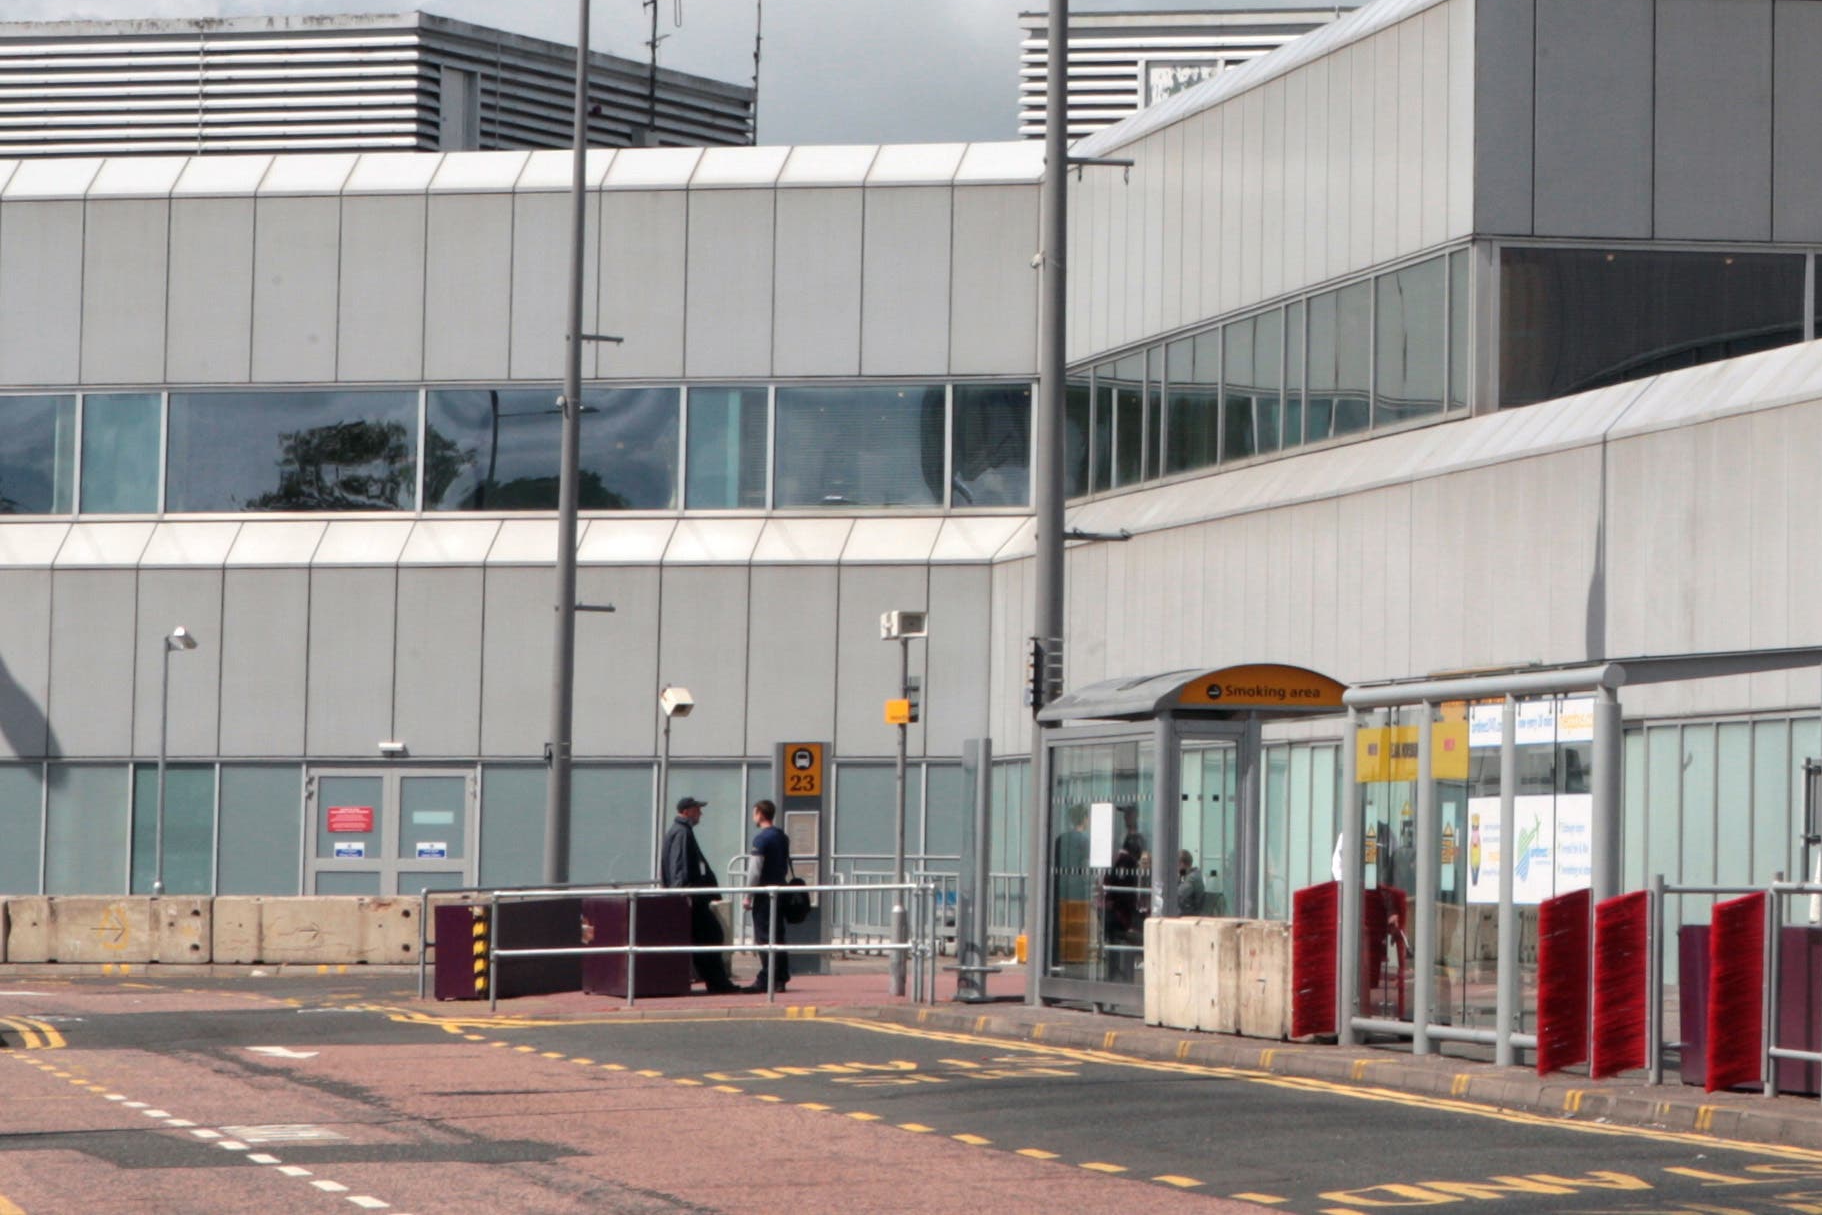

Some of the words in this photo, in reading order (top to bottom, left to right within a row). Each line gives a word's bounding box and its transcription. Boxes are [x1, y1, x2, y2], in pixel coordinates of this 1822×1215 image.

[1225, 685, 1286, 700] Smoking
[1290, 688, 1321, 698] area
[790, 775, 815, 792] 23
